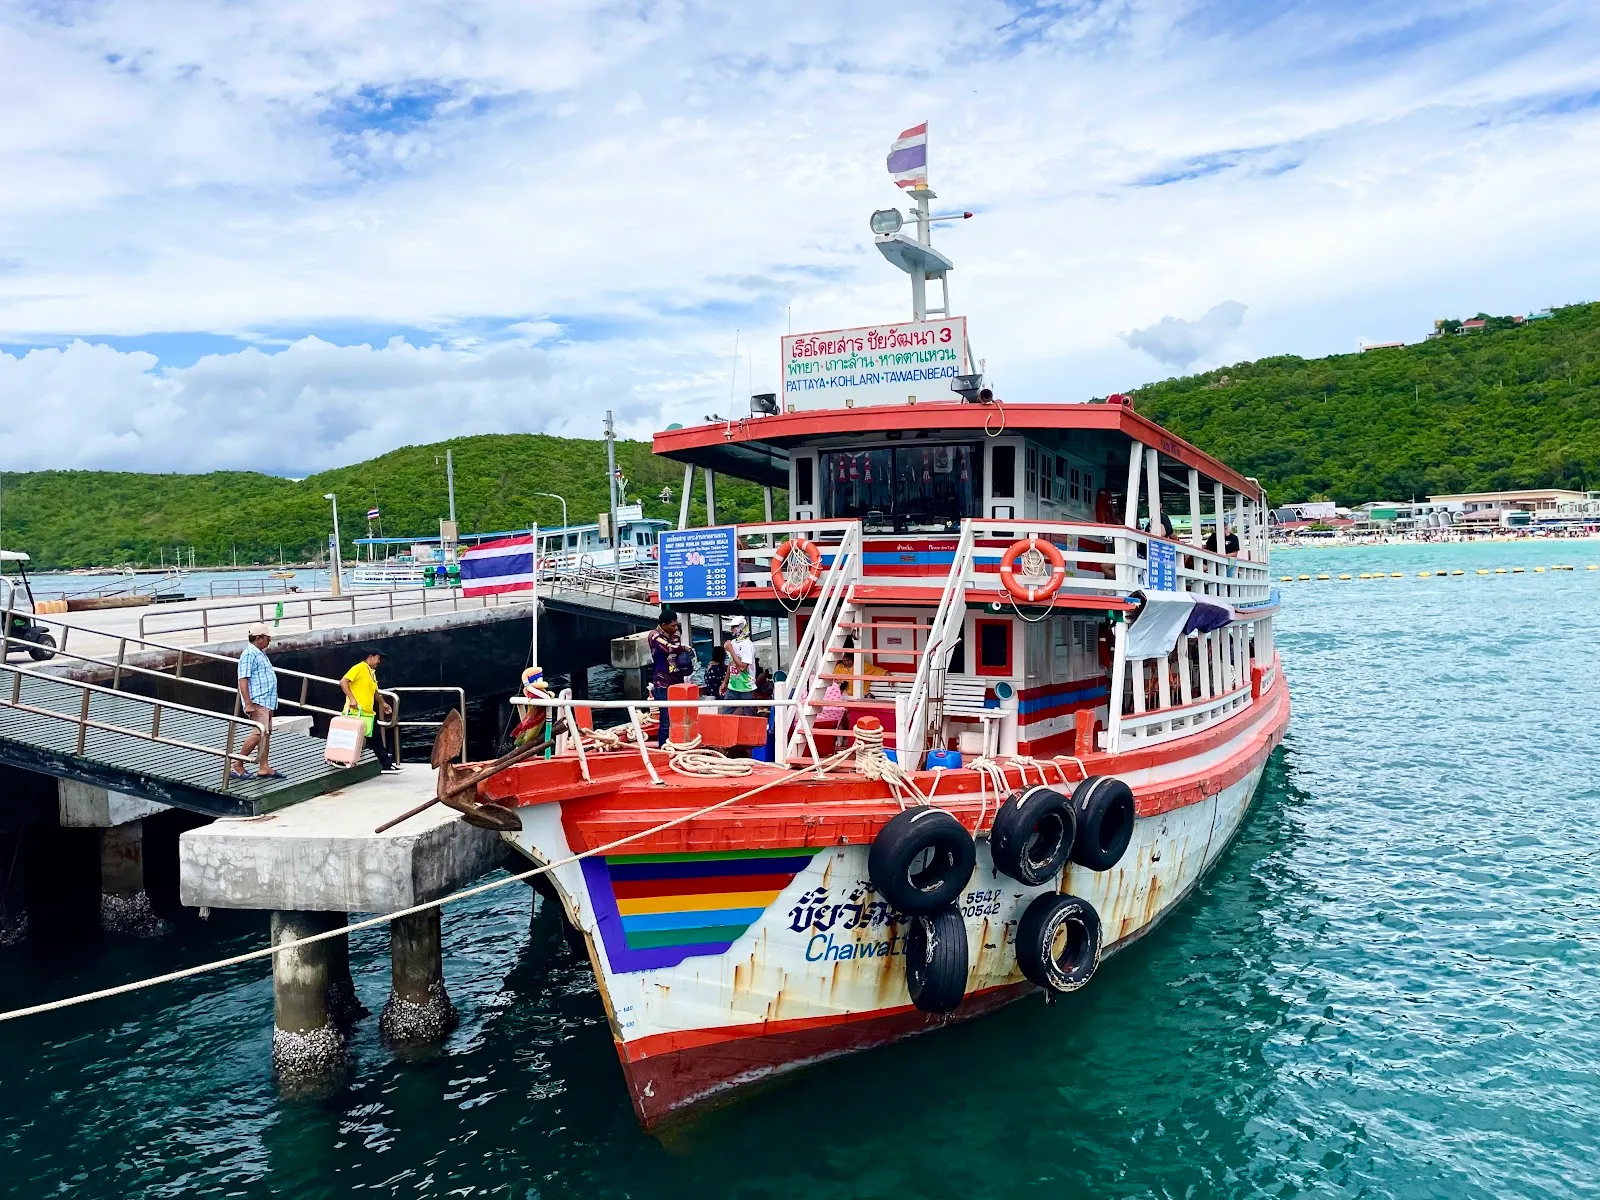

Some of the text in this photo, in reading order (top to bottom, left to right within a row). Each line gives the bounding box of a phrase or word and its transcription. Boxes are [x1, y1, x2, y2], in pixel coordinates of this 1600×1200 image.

[792, 327, 952, 358] เรือโดยสาร ชัยวัฒนา 3
[786, 365, 960, 392] PATTAYA KOHLARN TAWAENBEACH
[788, 359, 820, 375] พัทยา
